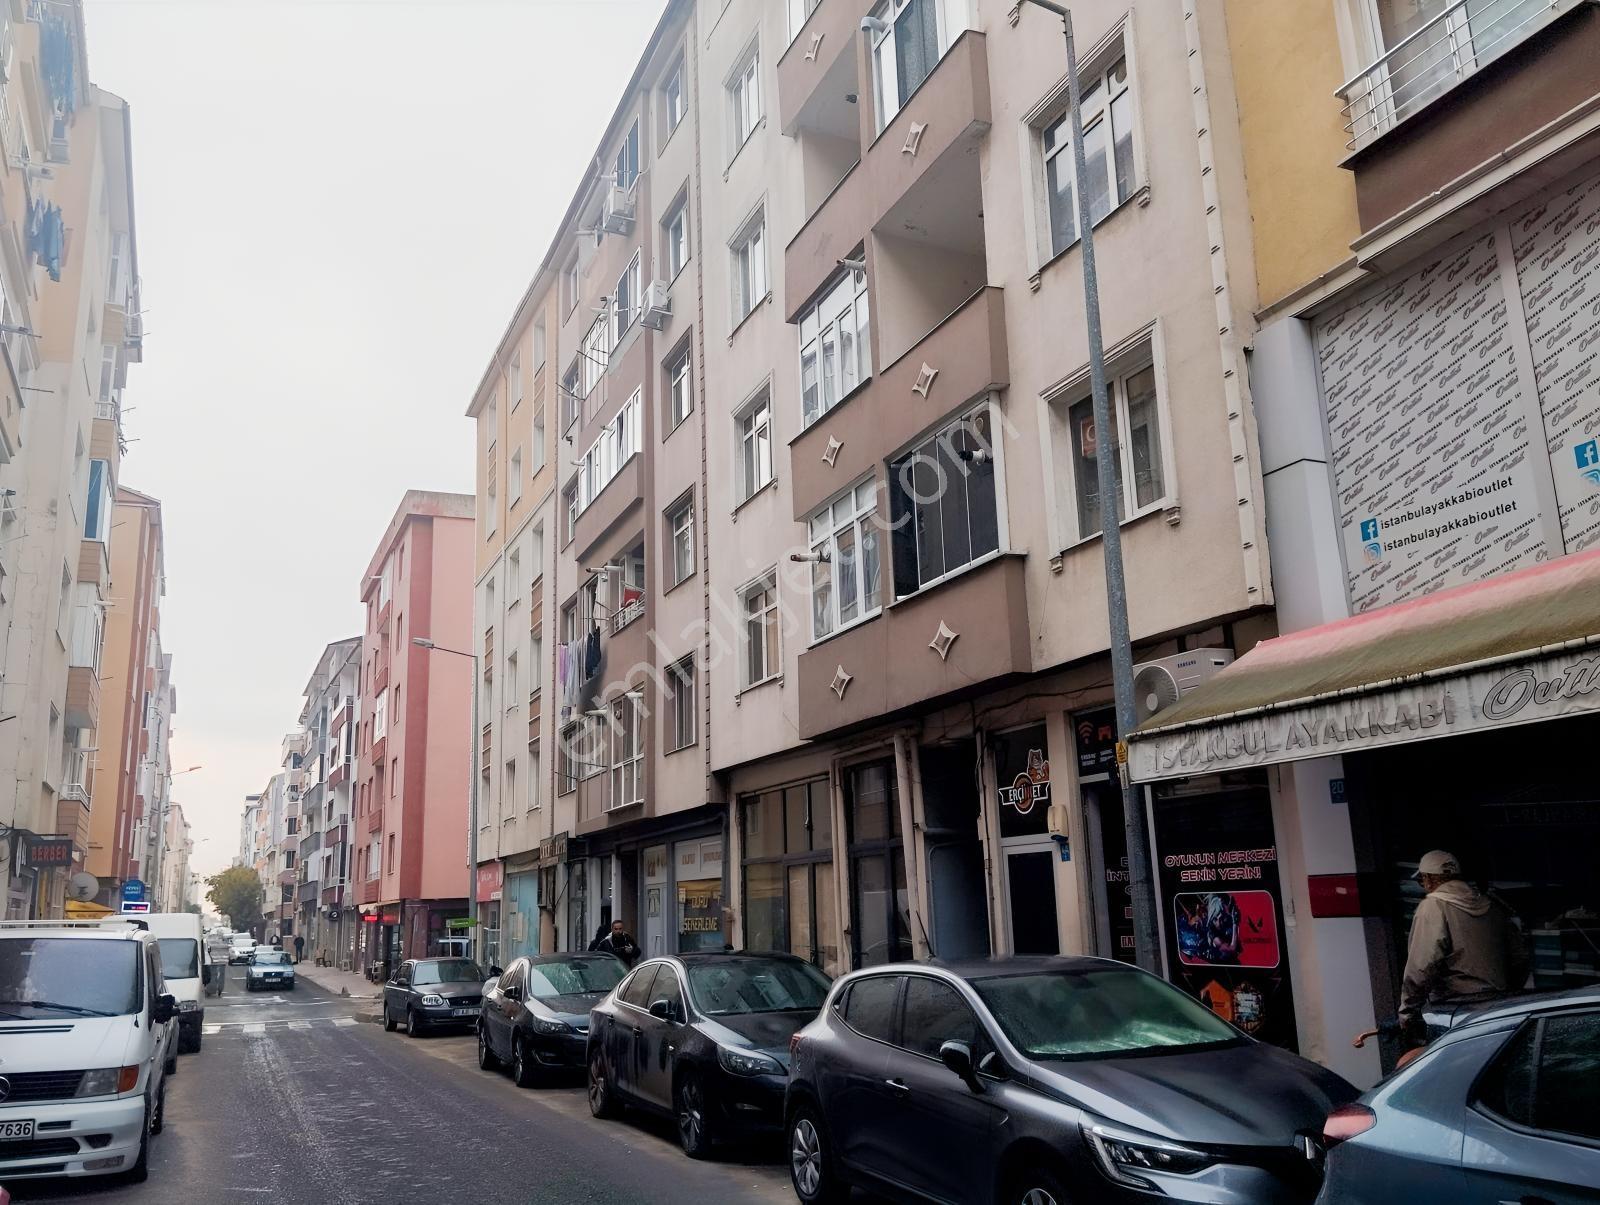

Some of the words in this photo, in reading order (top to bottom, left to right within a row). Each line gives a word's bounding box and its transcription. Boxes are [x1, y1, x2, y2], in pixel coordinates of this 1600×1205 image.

[1380, 476, 1513, 530] istanbulayakkabioutlet
[1384, 500, 1517, 552] istanbulayakkabioutlet
[31, 846, 67, 862] BERBER
[1164, 852, 1216, 868] OYUNUN
[1180, 866, 1216, 882] SENİN
